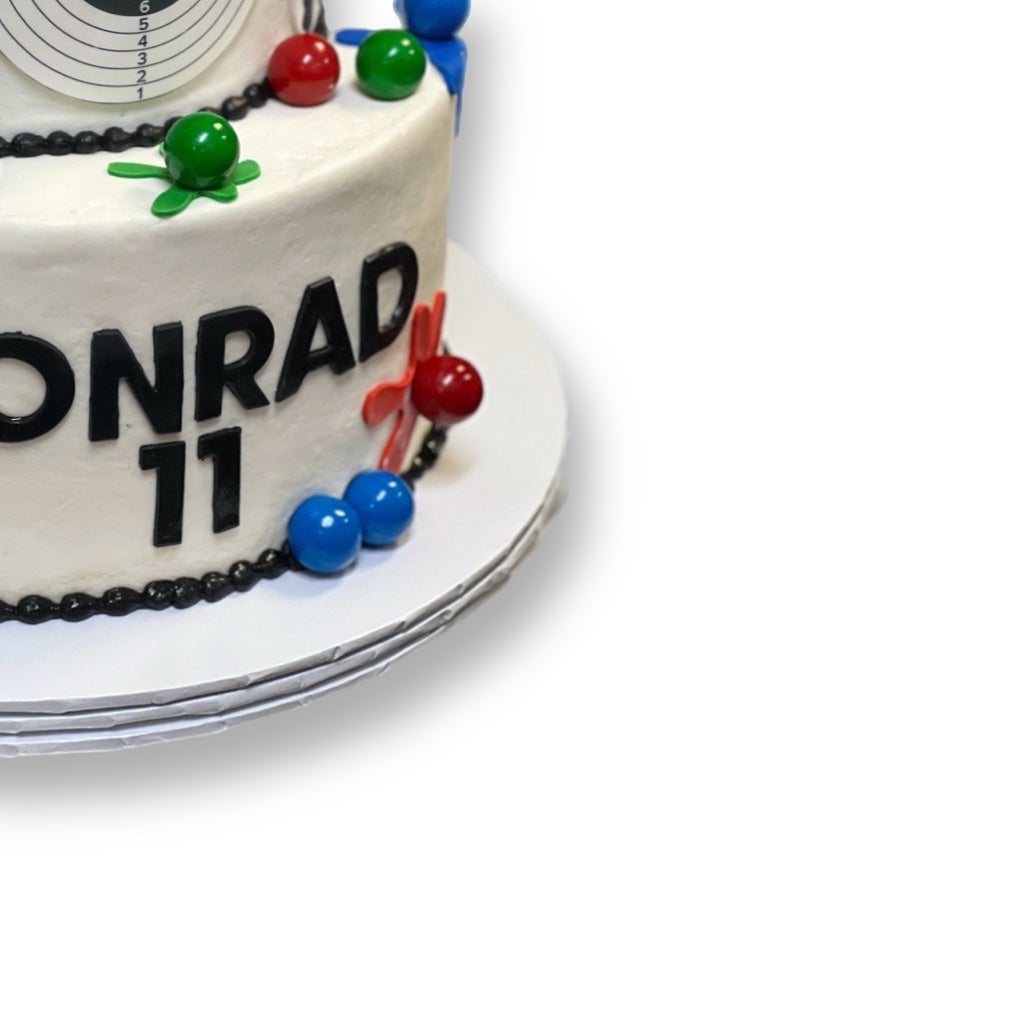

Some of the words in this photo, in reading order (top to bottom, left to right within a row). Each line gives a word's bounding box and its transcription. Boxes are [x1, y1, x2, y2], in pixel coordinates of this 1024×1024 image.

[140, 0, 150, 13] 6
[138, 18, 148, 31] 5
[137, 34, 148, 47] 4
[137, 52, 147, 65] 3
[136, 70, 146, 83] 2
[137, 87, 144, 100] 1
[139, 427, 242, 547] 11
